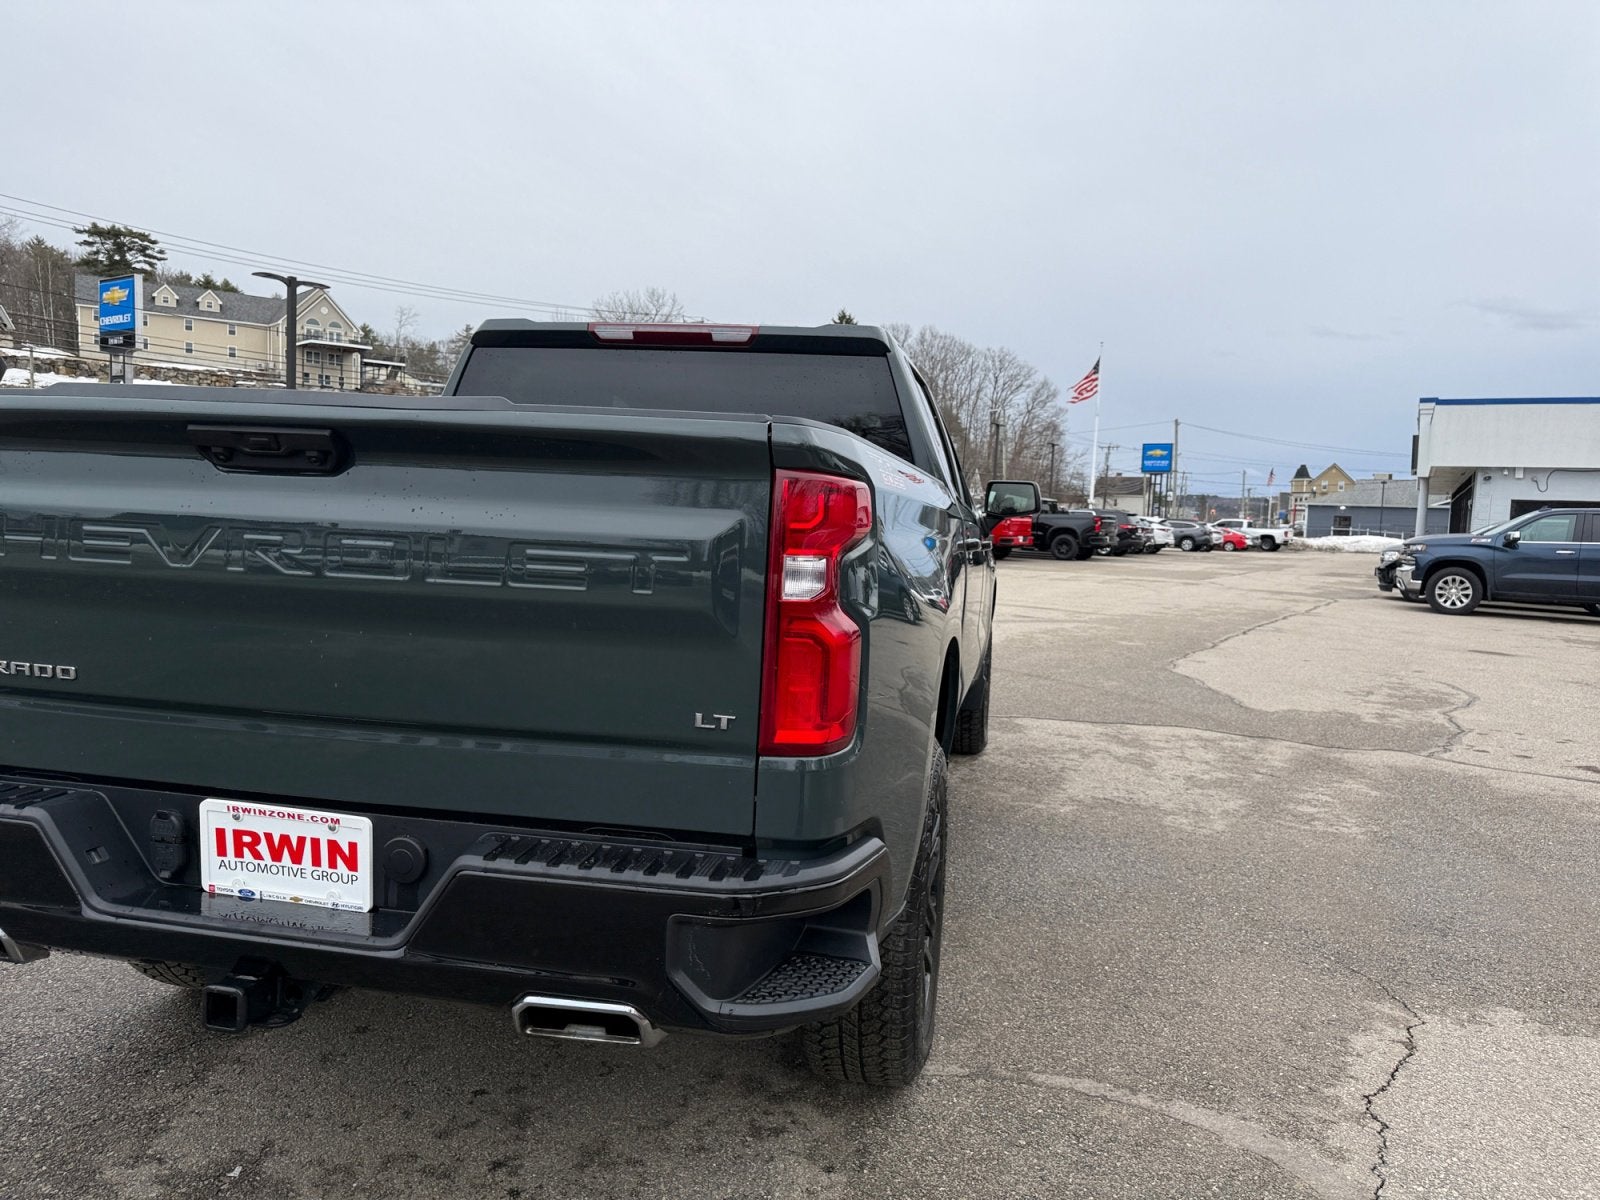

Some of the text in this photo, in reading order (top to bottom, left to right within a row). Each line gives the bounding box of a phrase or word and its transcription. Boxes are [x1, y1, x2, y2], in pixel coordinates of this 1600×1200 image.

[100, 313, 132, 326] CHEVROLET
[694, 712, 736, 731] LT
[226, 805, 341, 826] IRWINZONE.COM
[215, 827, 359, 873] IRWIN
[218, 859, 359, 886] AUTOMOTIVE GROUP
